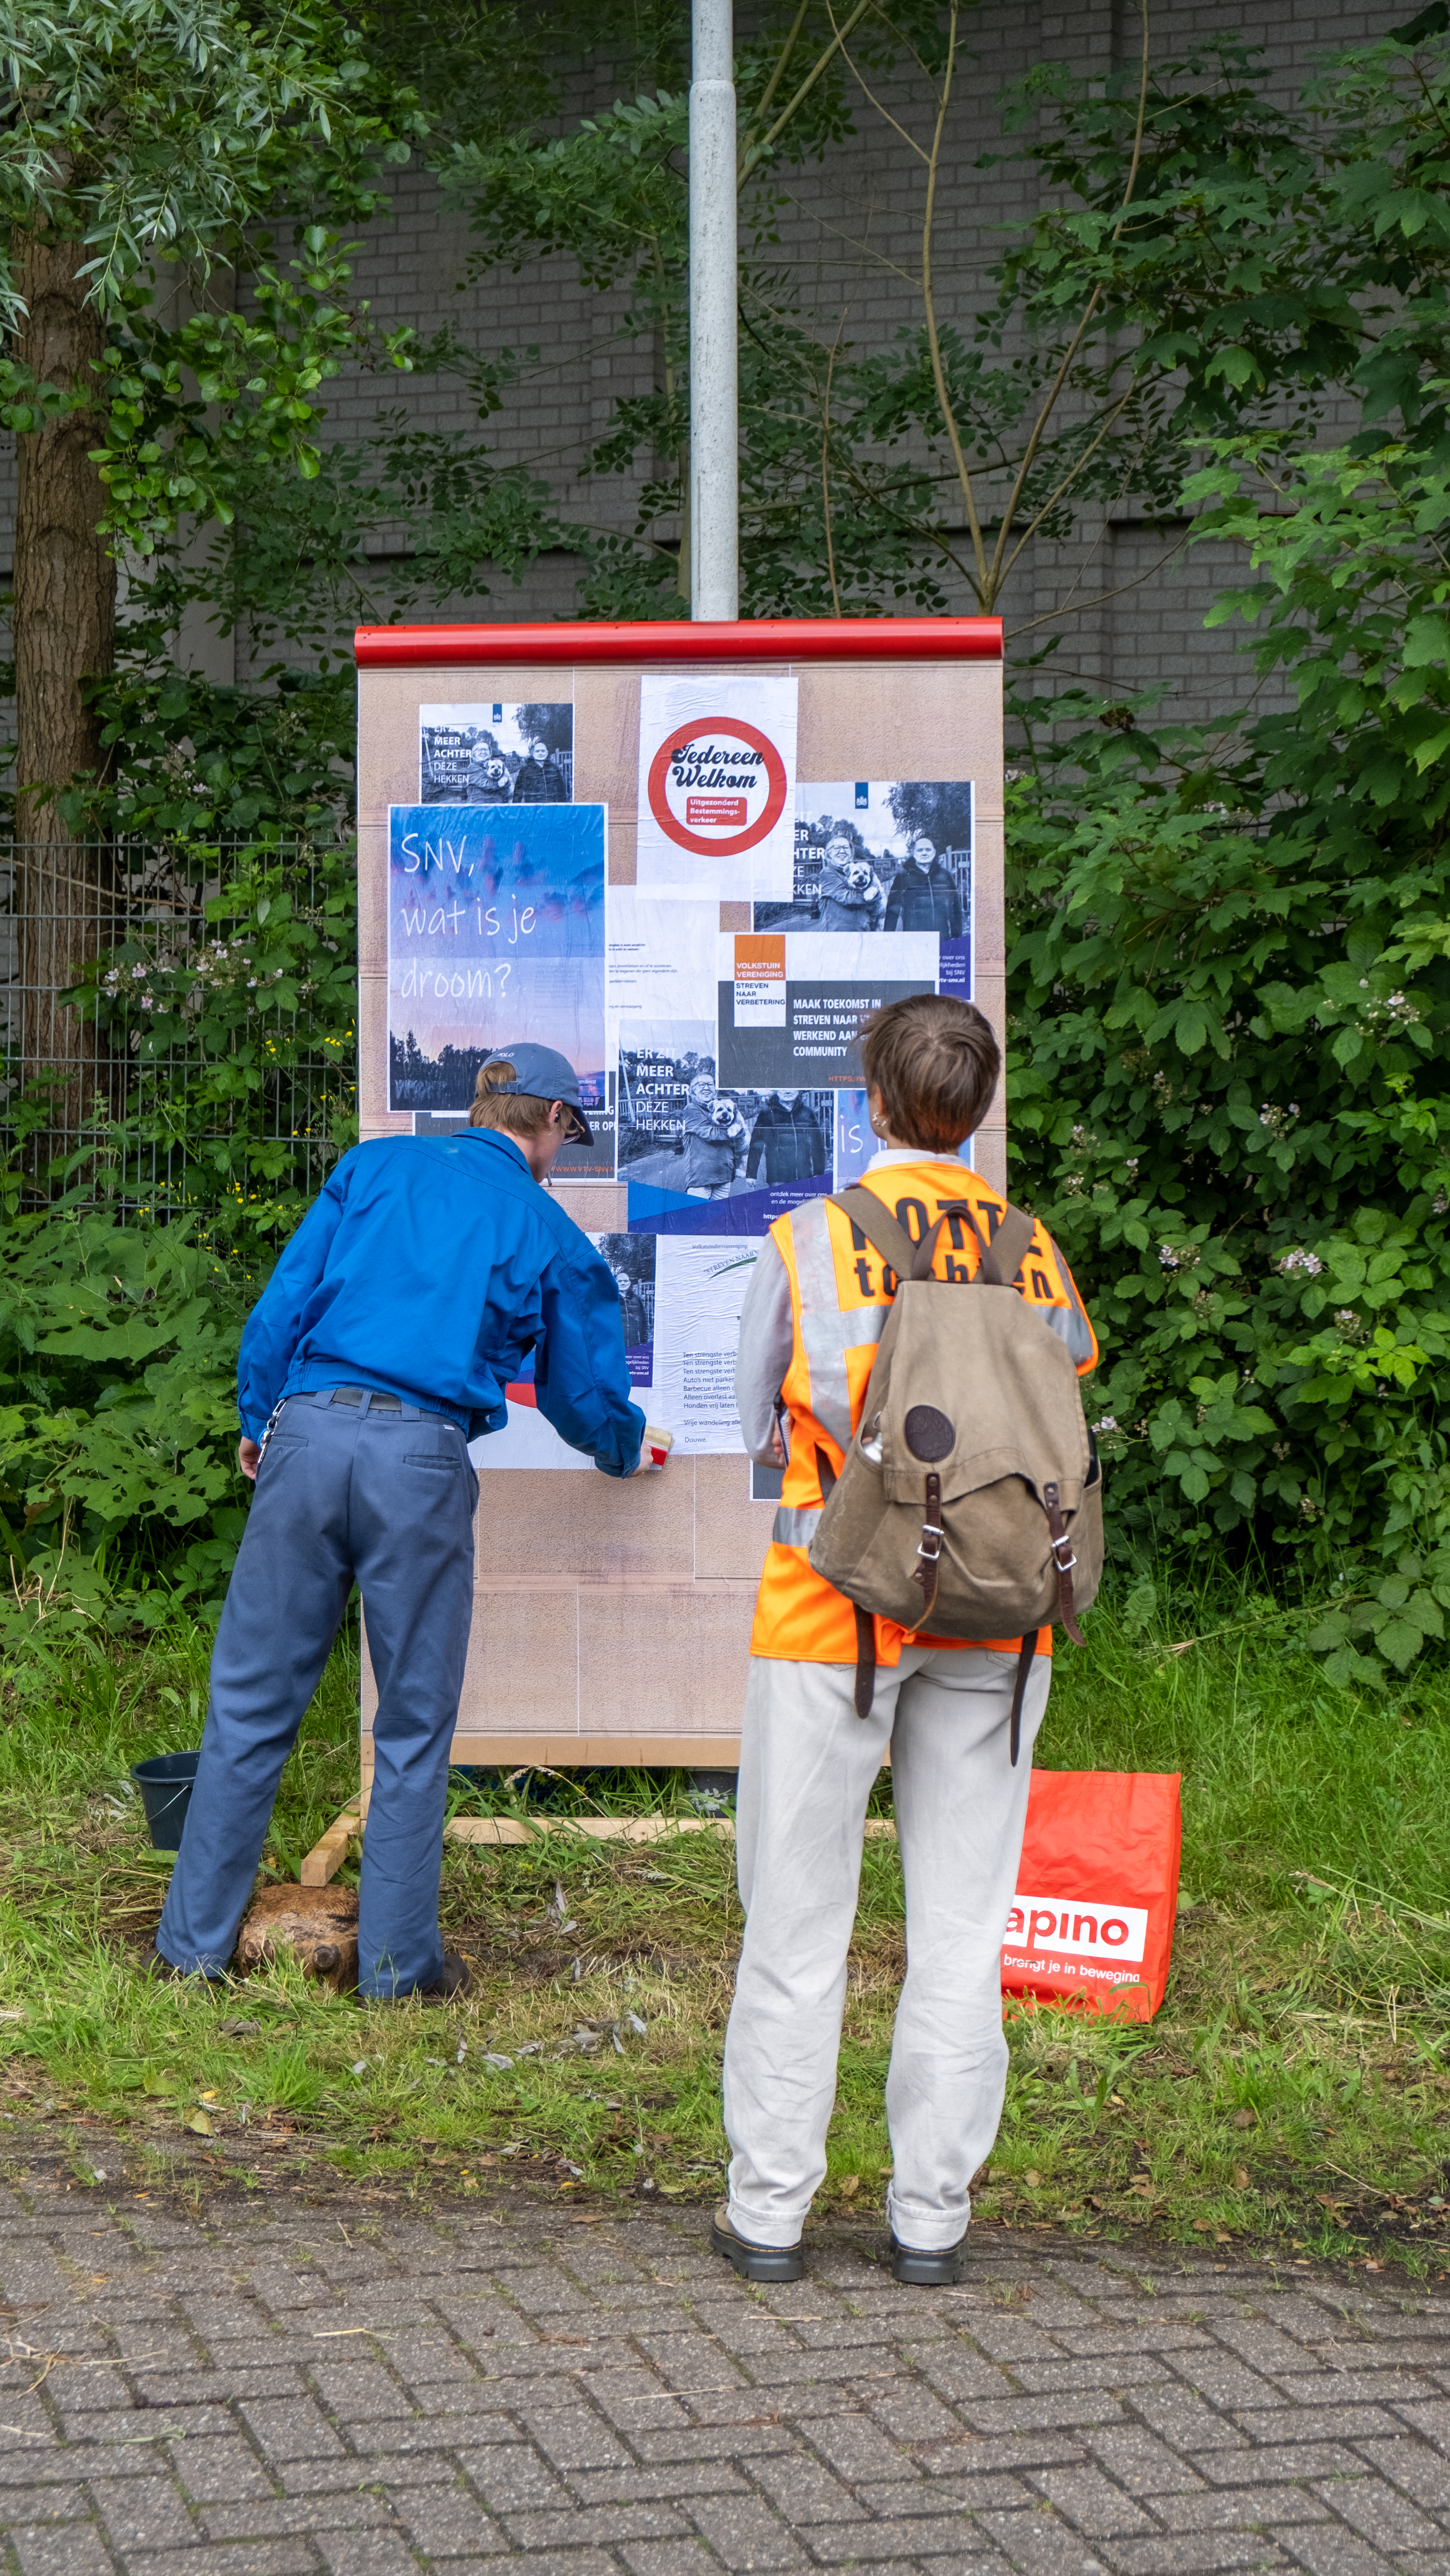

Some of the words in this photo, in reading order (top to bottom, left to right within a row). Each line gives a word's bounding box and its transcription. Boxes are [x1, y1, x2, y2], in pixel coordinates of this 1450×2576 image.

[434, 736, 461, 745] MEER
[434, 749, 472, 758] ACHTER
[671, 744, 764, 765] Iedereen
[434, 762, 457, 770] DEZE
[434, 775, 469, 783] HEKKEN
[672, 764, 757, 788] Welkom
[690, 808, 740, 816] Bestemmings-
[795, 829, 809, 841] ER
[401, 833, 474, 877] SNV,
[794, 847, 825, 859] HTER
[793, 866, 804, 877] ZE
[793, 884, 821, 894] KKEN
[401, 900, 466, 937] wat
[476, 897, 500, 935] is
[508, 893, 536, 944] je
[401, 956, 511, 998] droom?
[793, 999, 821, 1009] MAAK
[823, 999, 870, 1009] TOEKOMST
[872, 999, 882, 1008] IN
[793, 1014, 831, 1025] STREVEN
[833, 1014, 858, 1025] NAAR
[793, 1031, 836, 1040] WERKEND
[838, 1031, 857, 1040] AAN
[637, 1047, 653, 1059] ER
[656, 1047, 678, 1059] ZIT
[793, 1046, 848, 1056] COMMUNITY
[637, 1065, 674, 1077] MEER
[636, 1083, 690, 1095] ACHTER
[637, 1101, 668, 1112] DEZE
[589, 1121, 600, 1131] ER
[636, 1119, 686, 1130] HEKKEN
[840, 1114, 863, 1153] is
[850, 1197, 1043, 1256] OTT
[736, 1251, 754, 1261] NAAR
[1006, 1907, 1129, 1948] apino
[1003, 1954, 1045, 1972] brengt
[1048, 1959, 1060, 1973] je
[1065, 1963, 1076, 1974] in
[1080, 1965, 1140, 1983] beweging
